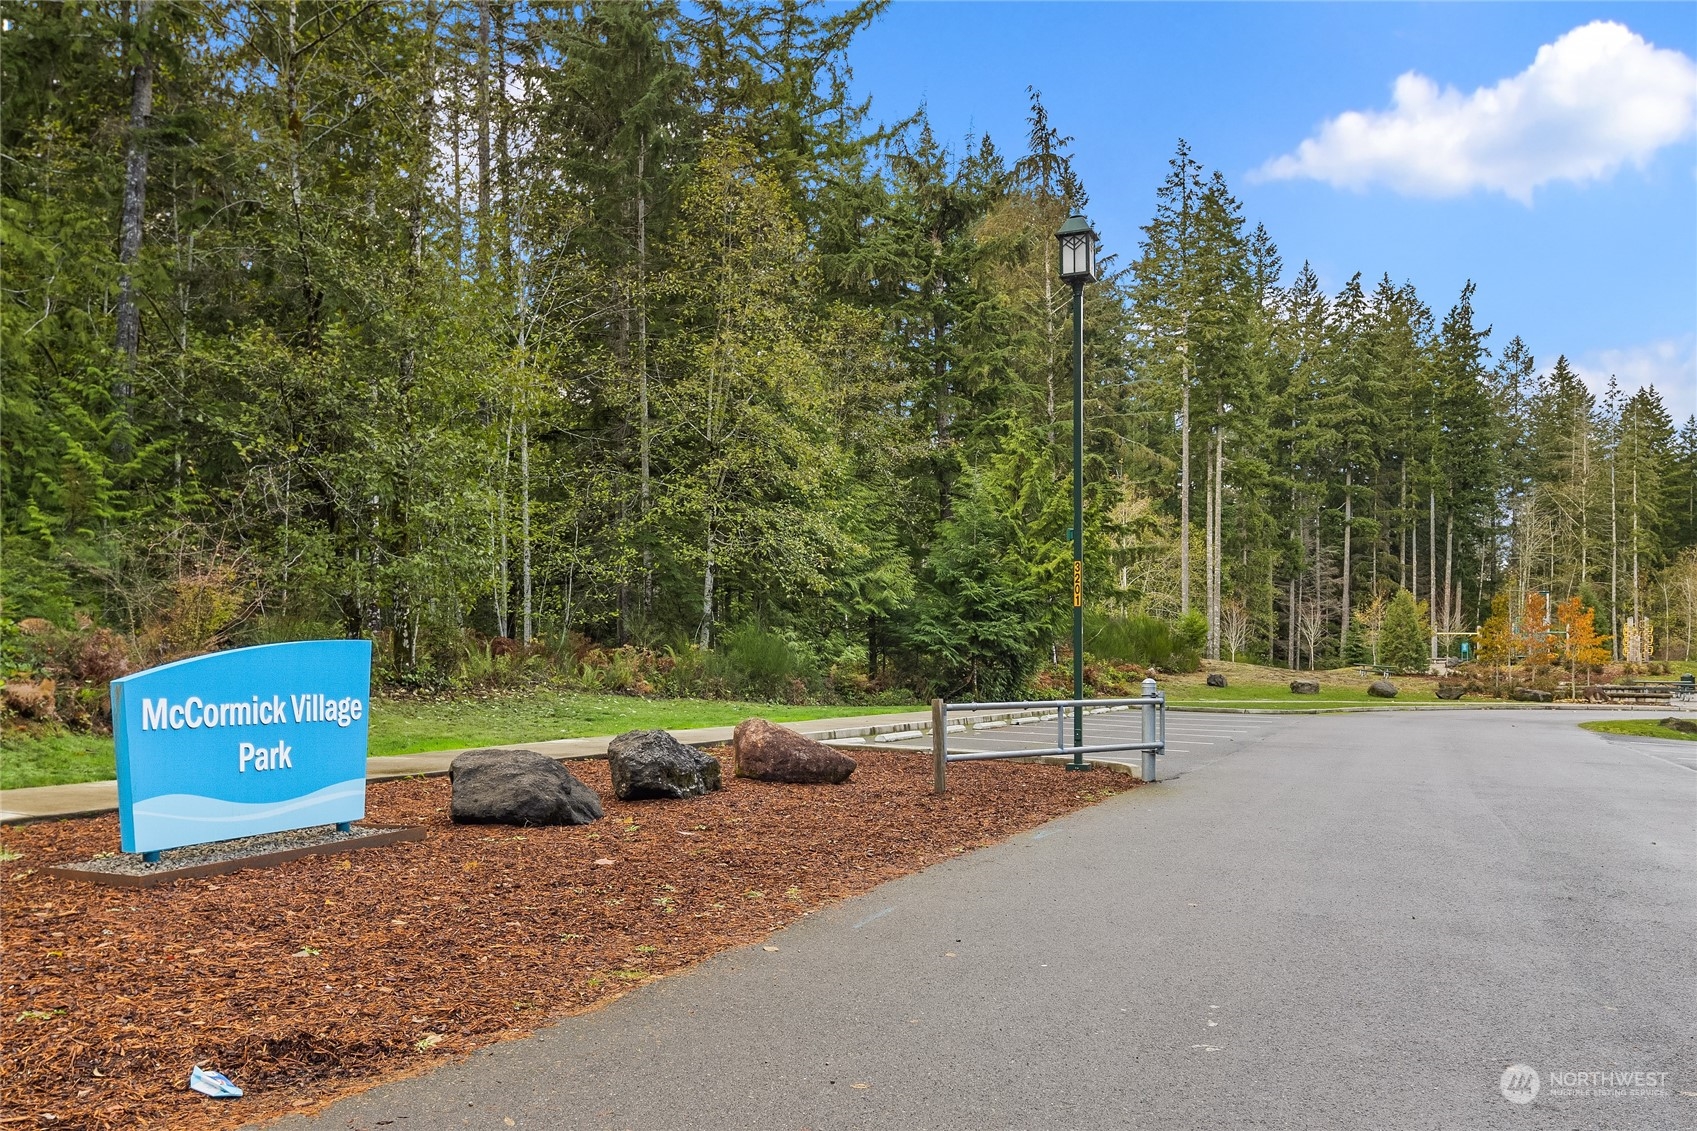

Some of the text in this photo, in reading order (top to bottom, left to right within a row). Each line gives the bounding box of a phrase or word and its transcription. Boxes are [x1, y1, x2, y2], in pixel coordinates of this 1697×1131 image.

[142, 694, 362, 730] McCormick Village
[239, 740, 292, 772] Park
